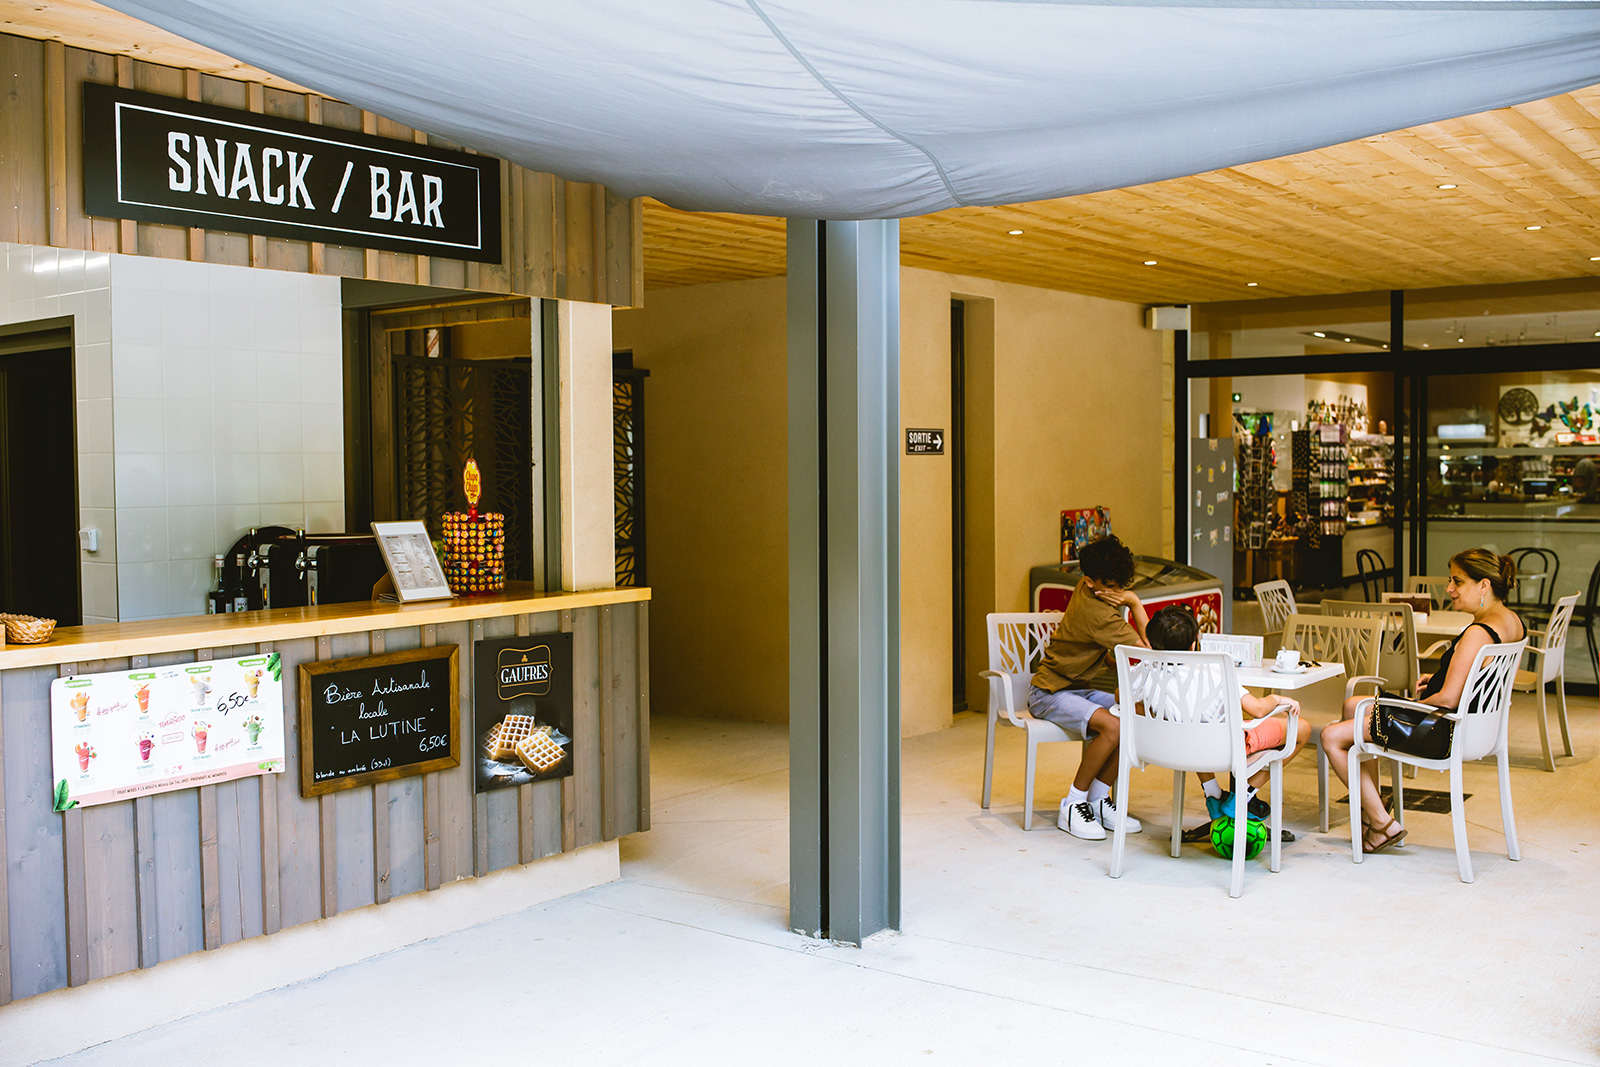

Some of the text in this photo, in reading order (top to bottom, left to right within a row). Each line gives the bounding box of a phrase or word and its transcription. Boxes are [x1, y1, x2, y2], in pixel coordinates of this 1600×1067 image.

[168, 131, 445, 229] SNACK / BAR
[909, 432, 932, 444] SORTIE
[914, 444, 926, 452] EXIT
[501, 663, 548, 684] GAUFRES
[323, 669, 430, 704] Bière Artisanale
[358, 700, 389, 719] locale
[341, 716, 427, 745] LA LUTINE
[419, 734, 448, 752] 6,50€
